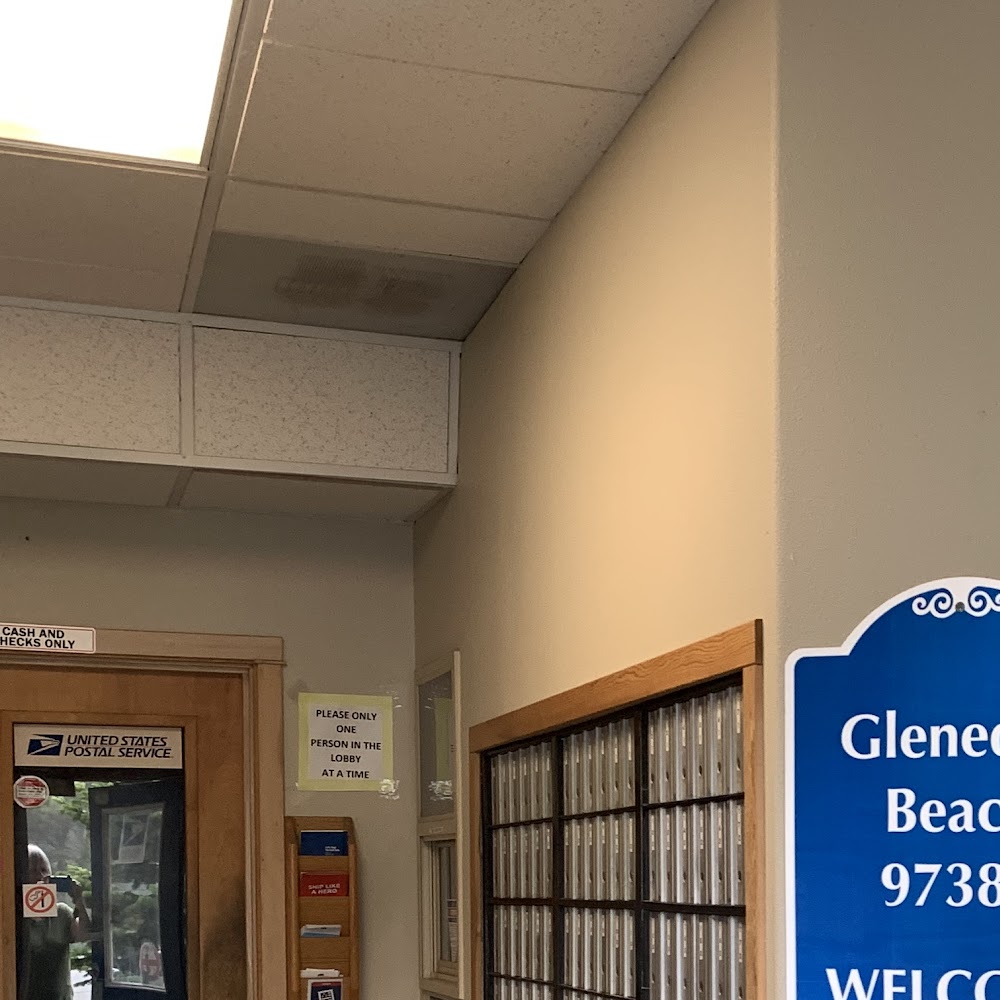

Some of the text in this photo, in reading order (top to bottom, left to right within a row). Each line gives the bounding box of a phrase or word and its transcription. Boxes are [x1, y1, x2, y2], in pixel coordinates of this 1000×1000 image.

[2, 626, 65, 639] CASH AND
[0, 636, 75, 649] HECKS ONLY
[316, 709, 378, 721] PLEASE ONLY
[336, 725, 357, 734] ONE
[67, 734, 168, 747] UNITED STATES
[310, 738, 382, 751] PERSON IN THE
[64, 746, 172, 759] POSTAL SERVICE
[330, 754, 362, 763] LOBBY
[321, 769, 370, 779] AT A TIME
